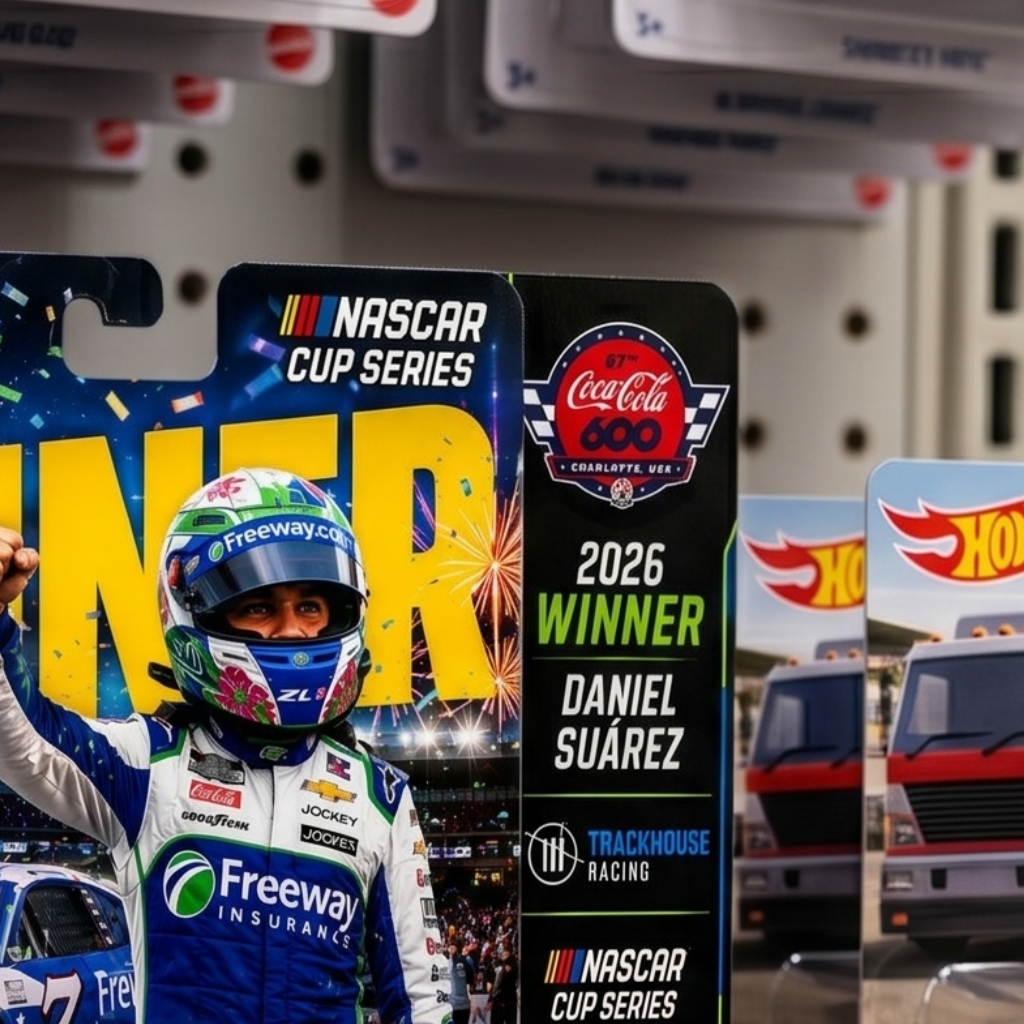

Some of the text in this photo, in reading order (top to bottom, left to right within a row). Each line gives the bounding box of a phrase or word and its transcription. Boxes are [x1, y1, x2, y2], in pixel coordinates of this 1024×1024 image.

[332, 296, 487, 343] NASCAR
[287, 347, 475, 388] CUP SERIES
[580, 416, 663, 452] 600
[576, 541, 666, 586] 2026
[538, 592, 705, 646] WINNER
[561, 673, 677, 716] DANIEL
[554, 717, 685, 770] SUÁREZ
[301, 804, 358, 828] JOCKEY
[588, 829, 711, 857] TRACKHOUSE
[588, 860, 651, 883] RACING
[220, 857, 360, 933] Freeway
[580, 948, 687, 984] NASCAR
[550, 990, 678, 1021] CUP SERIES
